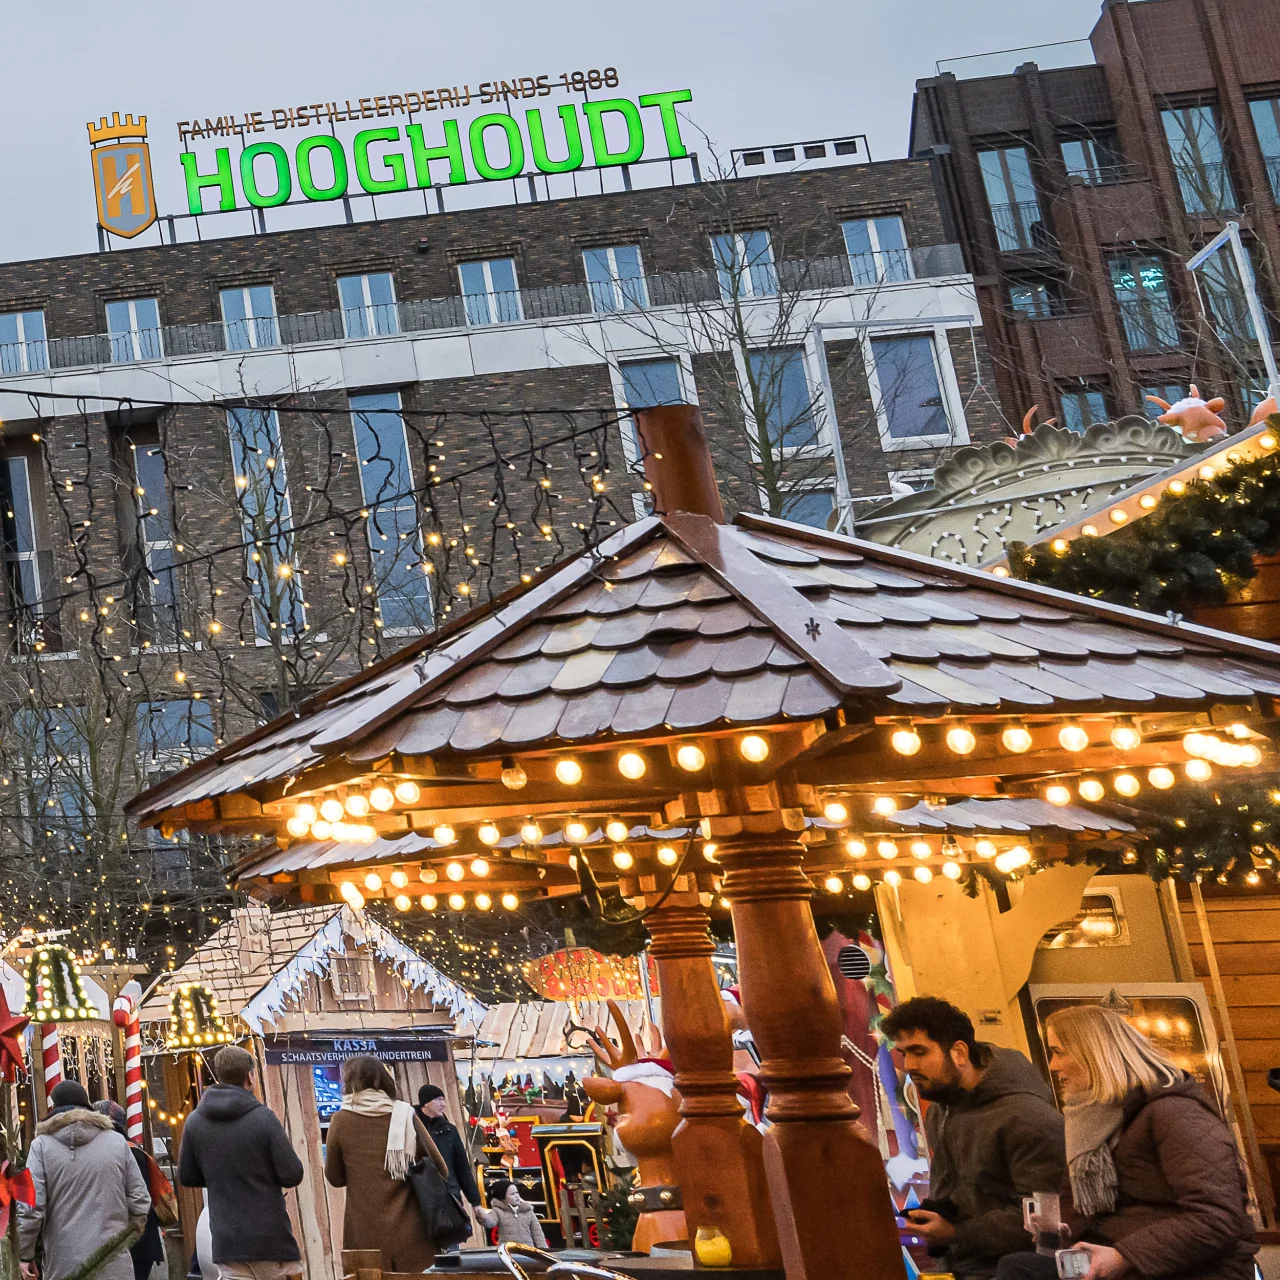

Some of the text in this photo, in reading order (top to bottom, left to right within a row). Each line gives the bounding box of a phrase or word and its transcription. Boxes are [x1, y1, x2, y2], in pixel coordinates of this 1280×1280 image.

[177, 67, 619, 142] FAMILIE DISTILLEERDERIJ SINDS 1888
[180, 89, 693, 215] HOOGHOUDT
[333, 1039, 377, 1052] KASSA
[373, 1050, 432, 1061] KINDERTREIN
